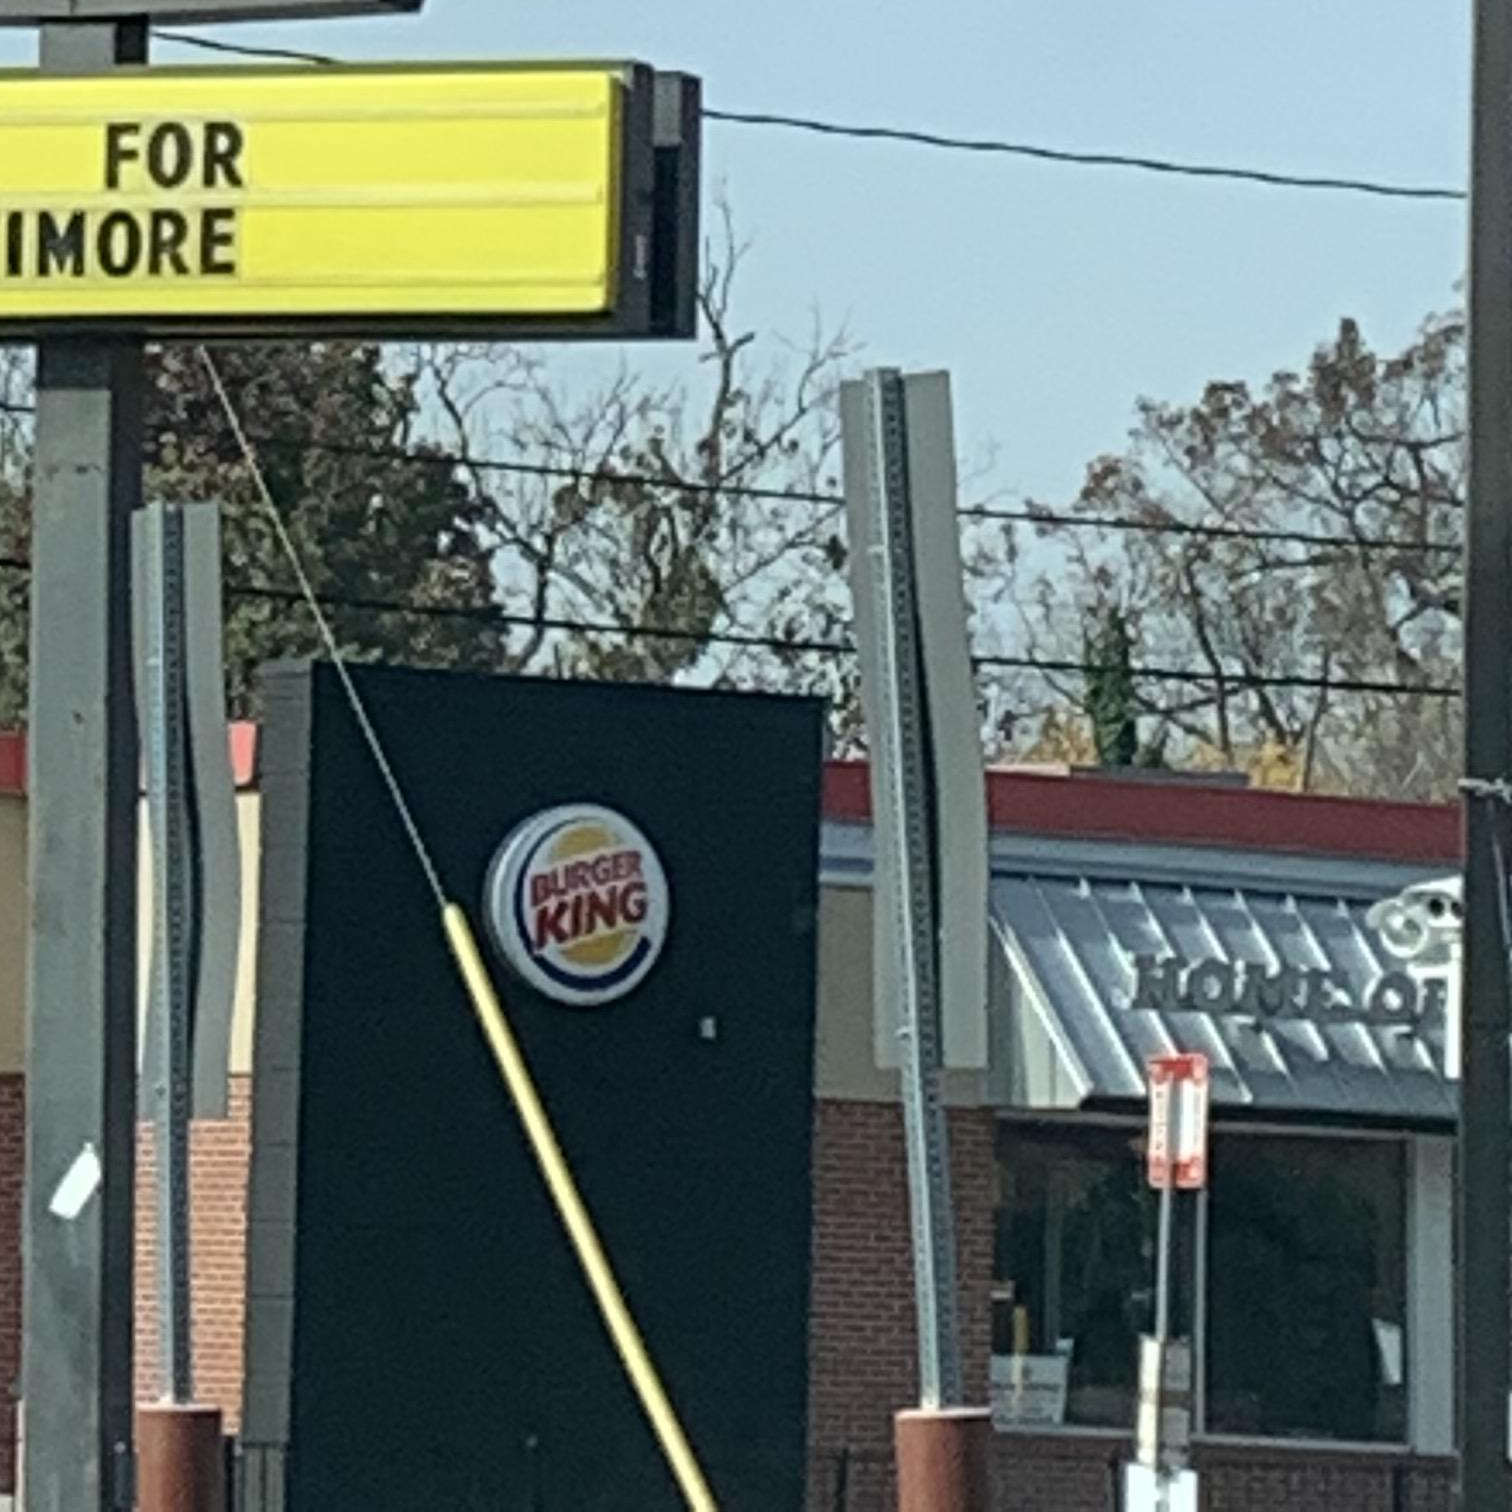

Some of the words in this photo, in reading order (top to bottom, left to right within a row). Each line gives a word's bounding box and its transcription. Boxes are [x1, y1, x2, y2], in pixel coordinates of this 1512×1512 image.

[104, 120, 244, 190] FOR
[530, 850, 644, 907] BURGER
[535, 882, 647, 950] KING
